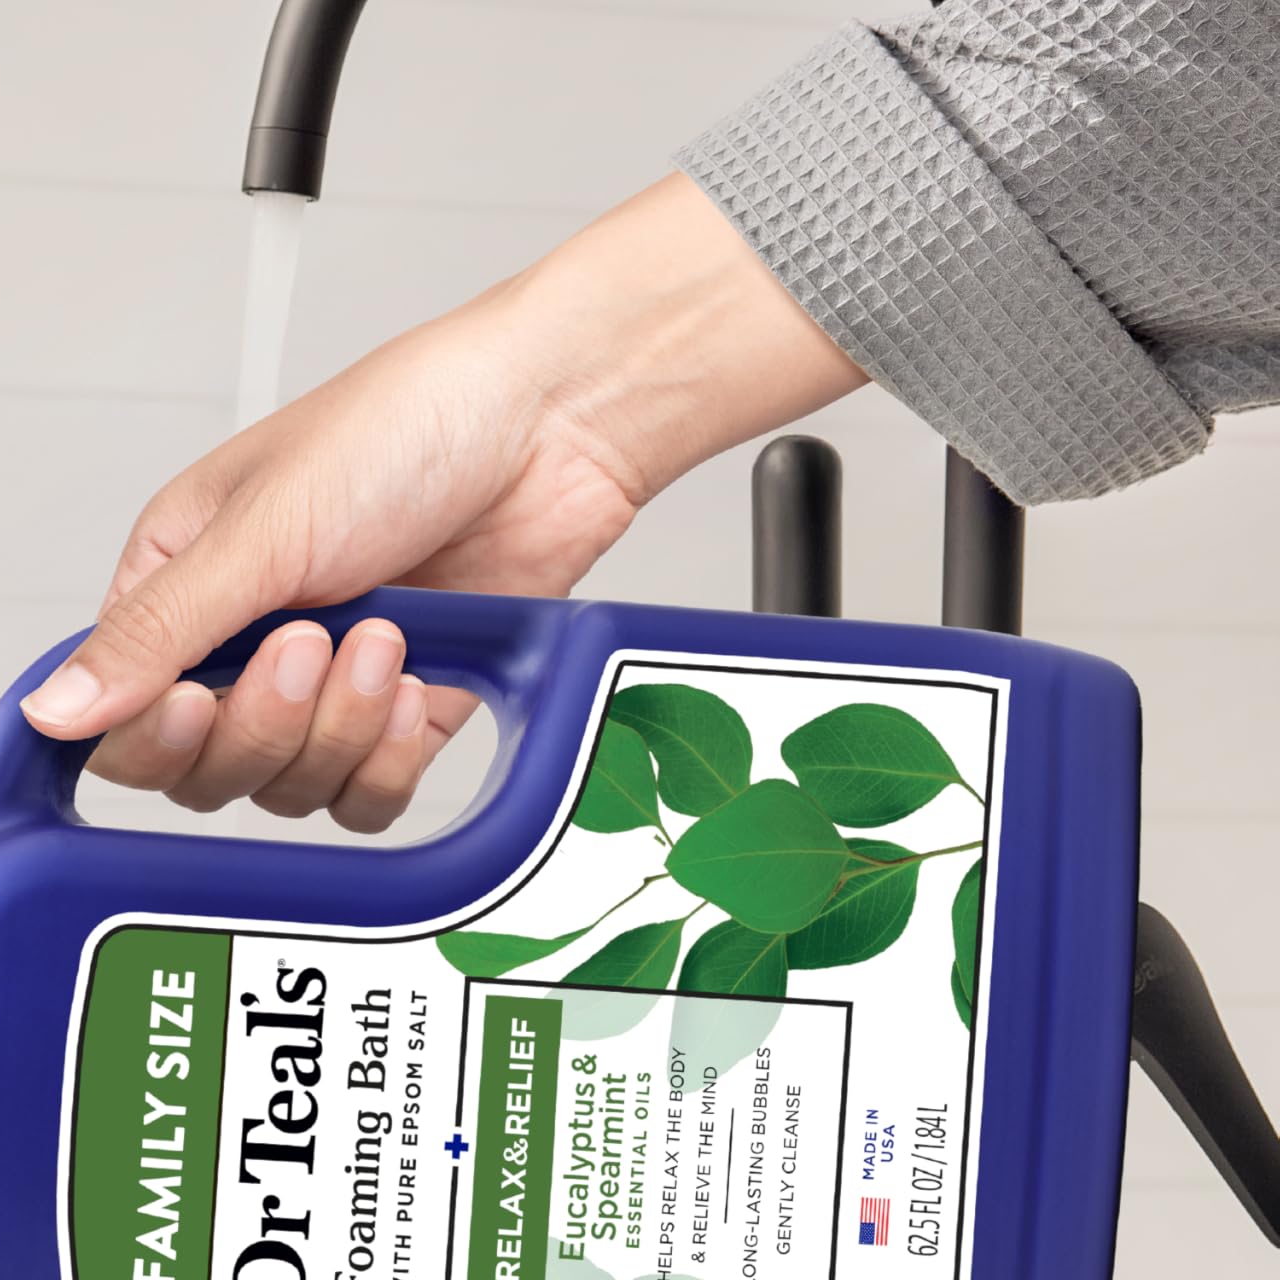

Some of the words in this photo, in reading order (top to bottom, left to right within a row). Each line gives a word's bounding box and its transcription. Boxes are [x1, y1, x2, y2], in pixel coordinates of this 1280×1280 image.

[146, 969, 195, 1080] SIZE
[347, 988, 391, 1092] Bath
[409, 990, 427, 1050] SALT
[572, 1054, 597, 1075] &
[669, 1047, 686, 1102] BODY
[402, 1063, 423, 1146] EPSOM
[635, 1072, 651, 1120] OILS
[701, 1066, 717, 1114] MIND
[752, 1048, 771, 1136] BUBBLES
[918, 1104, 948, 1113] L
[667, 1108, 682, 1145] THE
[698, 1121, 714, 1158] THE
[782, 1085, 801, 1174] CLEANSE
[866, 1109, 878, 1124] IN
[915, 1116, 946, 1151] 1.84
[591, 1073, 626, 1240] Spearmint
[862, 1131, 878, 1180] MADE
[881, 1124, 895, 1163] USA
[911, 1153, 948, 1166] /
[397, 1157, 416, 1222] PURE
[559, 1082, 596, 1261] Eucalyptus
[626, 1130, 647, 1248] ESSENTIAL
[661, 1151, 679, 1214] RELAX
[912, 1167, 943, 1191] OZ
[693, 1165, 710, 1245] RELIEVE
[777, 1180, 795, 1255] GENTLY
[909, 1195, 941, 1218] FL
[691, 1251, 705, 1263] &
[907, 1220, 939, 1256] 62.5
